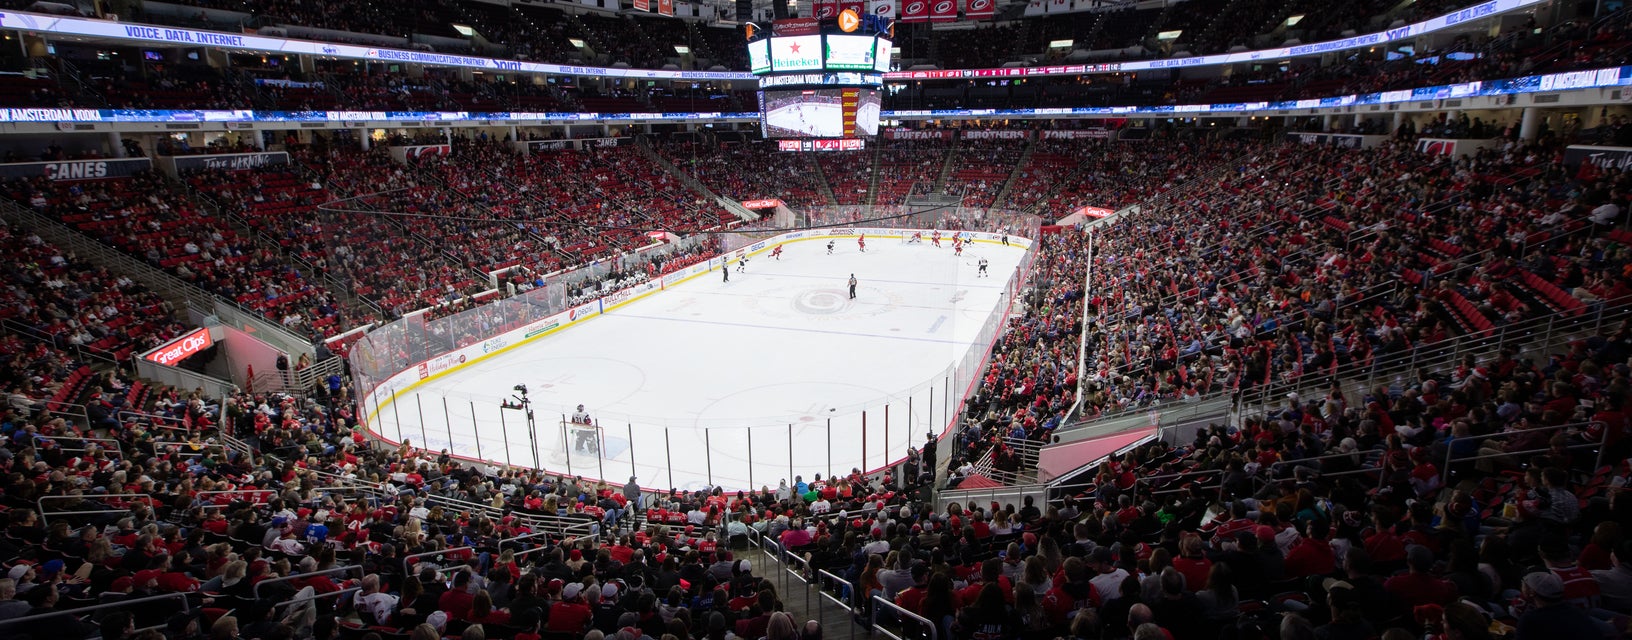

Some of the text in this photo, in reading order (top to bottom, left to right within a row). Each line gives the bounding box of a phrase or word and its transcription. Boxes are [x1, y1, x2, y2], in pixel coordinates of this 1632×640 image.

[124, 26, 245, 46] VOICE. DATA. INTERNET.
[378, 50, 485, 66] BUSINESS COMMUNICATIONS PARTNER
[773, 58, 819, 68] Heineken
[774, 74, 804, 84] AMSTERDAM
[805, 74, 823, 84] VODKA
[11, 108, 70, 121] AMSTERDAM
[73, 109, 102, 121] VODKA
[894, 131, 942, 139] BUFFALO
[967, 131, 1024, 139] BROTHERS
[1044, 130, 1074, 139] ZONE
[204, 154, 271, 170] TAKE WARNING
[44, 161, 108, 179] CANES
[751, 242, 765, 252] GEICO
[577, 305, 593, 318] pepsi
[154, 335, 205, 364] Great Clips
